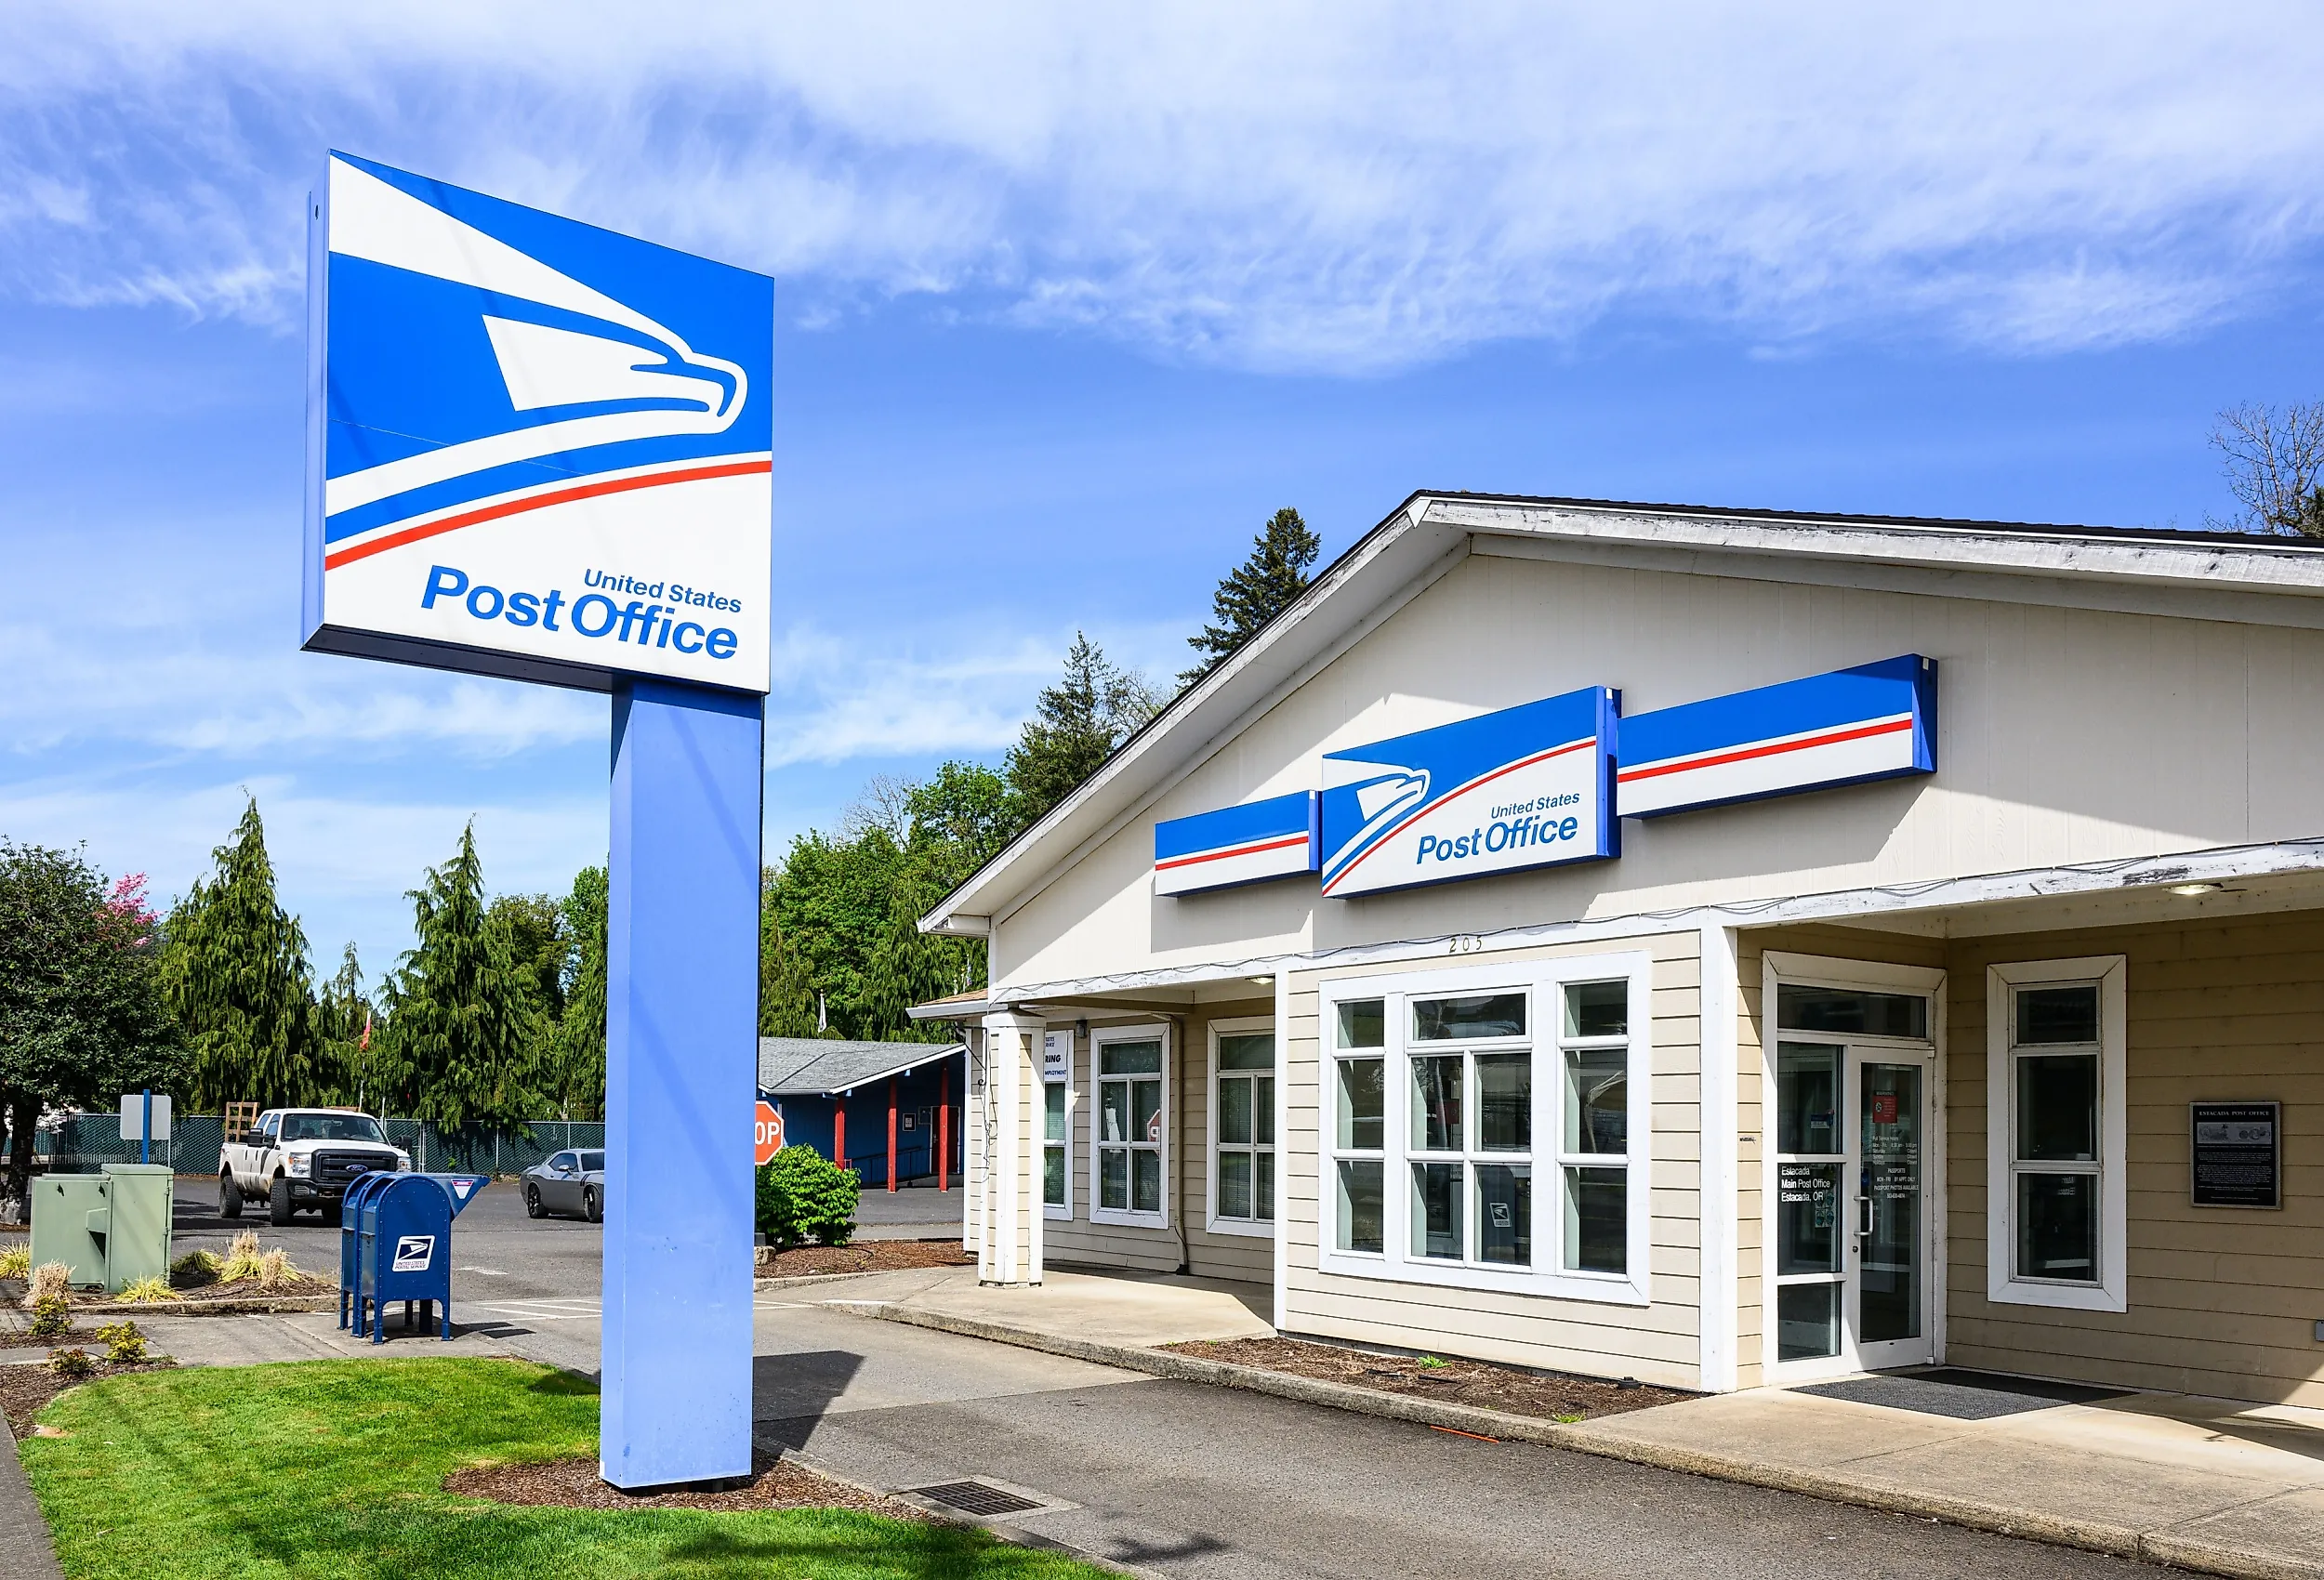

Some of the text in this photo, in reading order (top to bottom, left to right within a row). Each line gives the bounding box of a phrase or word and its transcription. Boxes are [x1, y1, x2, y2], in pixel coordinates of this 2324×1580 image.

[585, 569, 742, 613] United States
[421, 565, 738, 660] Post Office
[1490, 793, 1580, 820] United States
[1417, 815, 1579, 865] Post Office
[1449, 935, 1483, 954] 205
[1045, 1054, 1062, 1063] RING
[755, 1121, 781, 1145] OP
[1781, 1165, 1811, 1176] Estacada
[1781, 1178, 1831, 1189] Main Post Office
[1781, 1191, 1824, 1203] Estacada, OR
